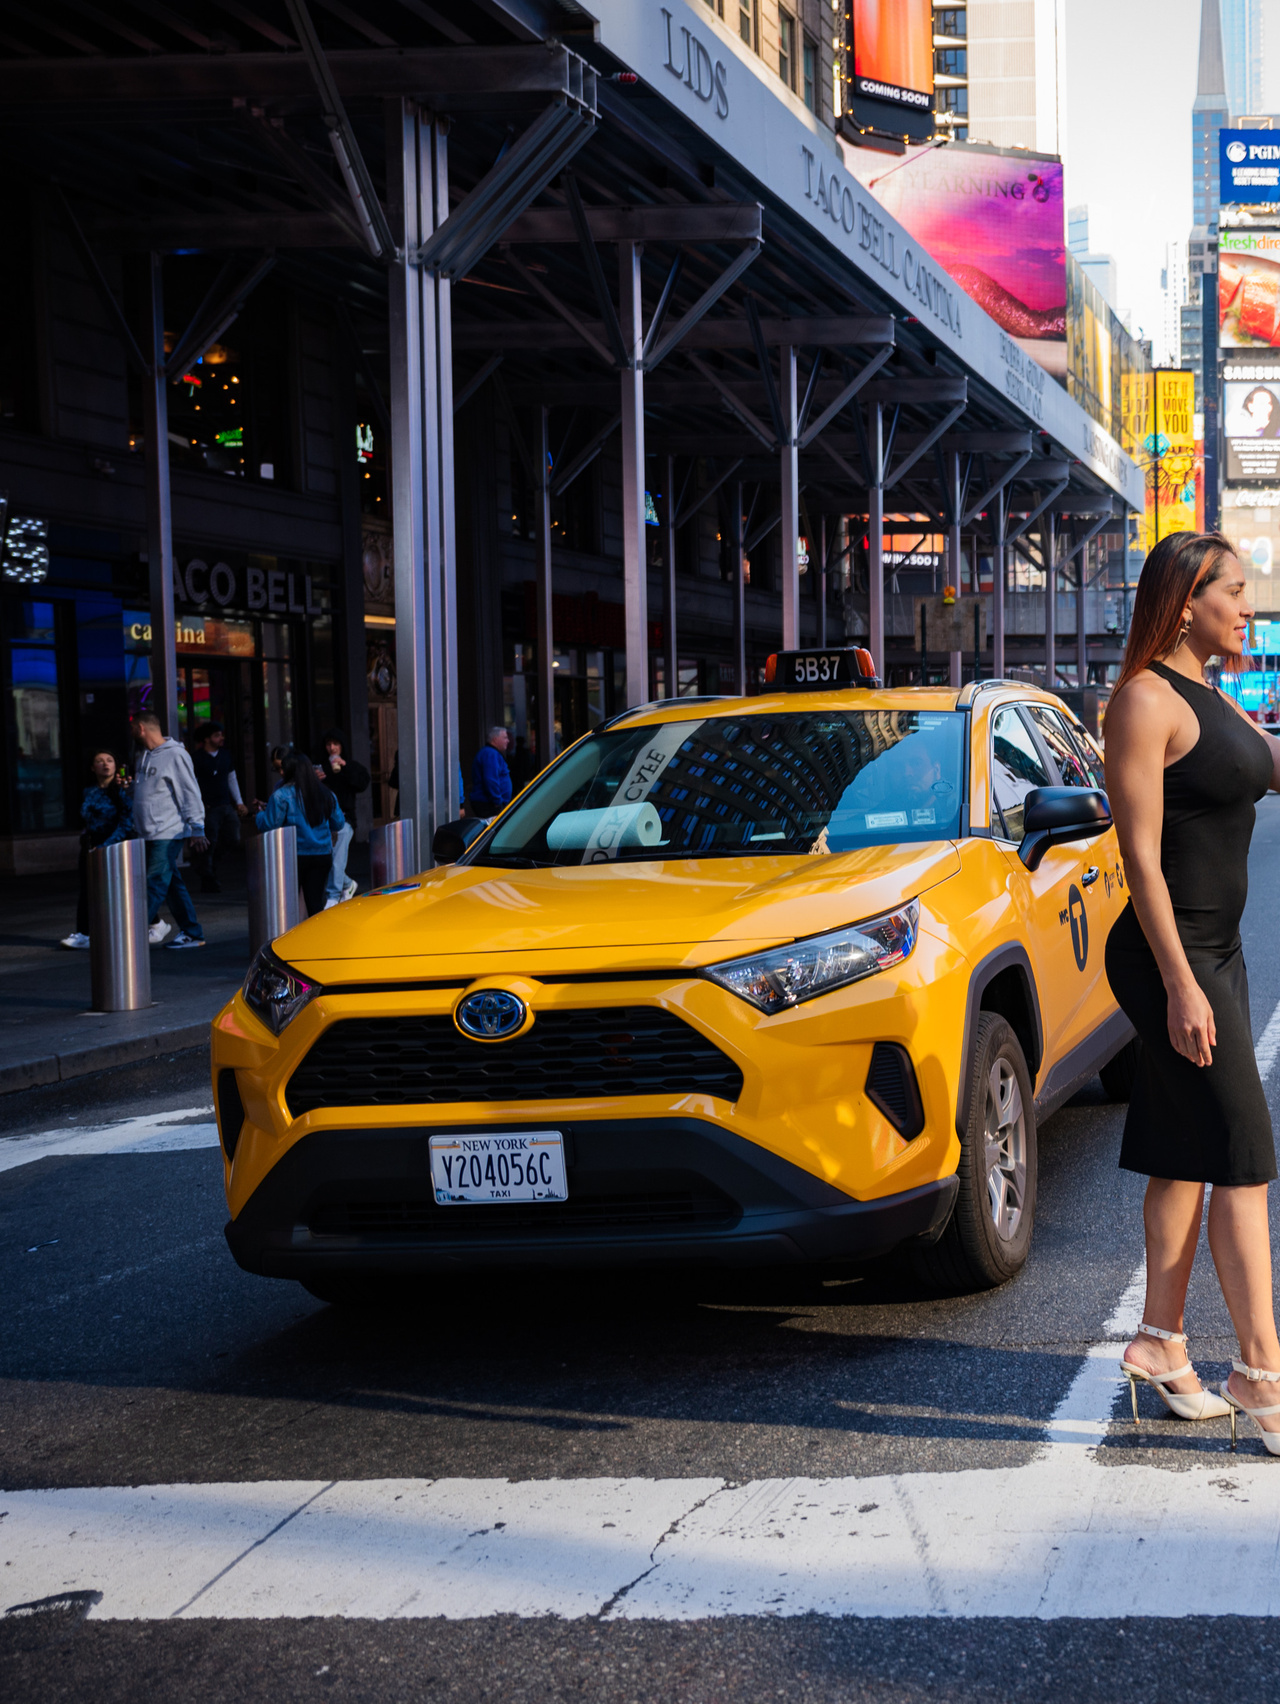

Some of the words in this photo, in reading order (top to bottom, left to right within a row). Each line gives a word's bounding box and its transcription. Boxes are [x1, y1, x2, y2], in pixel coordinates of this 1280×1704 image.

[662, 8, 729, 119] LIDS
[860, 79, 900, 100] COMING
[901, 85, 929, 107] SOON
[909, 171, 1025, 200] YEARNING
[802, 145, 855, 234] TACO
[858, 202, 900, 280] BELL
[903, 249, 963, 339] CANTINA
[1163, 382, 1178, 397] LET
[1164, 398, 1187, 413] MOVE
[1164, 413, 1188, 434] YOU
[139, 552, 237, 606] ACO
[247, 566, 322, 615] BELL
[131, 621, 206, 645] caina
[795, 656, 840, 682] 5B37
[1058, 908, 1070, 926] NYC
[462, 1140, 491, 1152] NEW
[492, 1138, 528, 1150] YORK
[441, 1151, 552, 1188] Y204056C
[490, 1190, 511, 1198] TAXI
